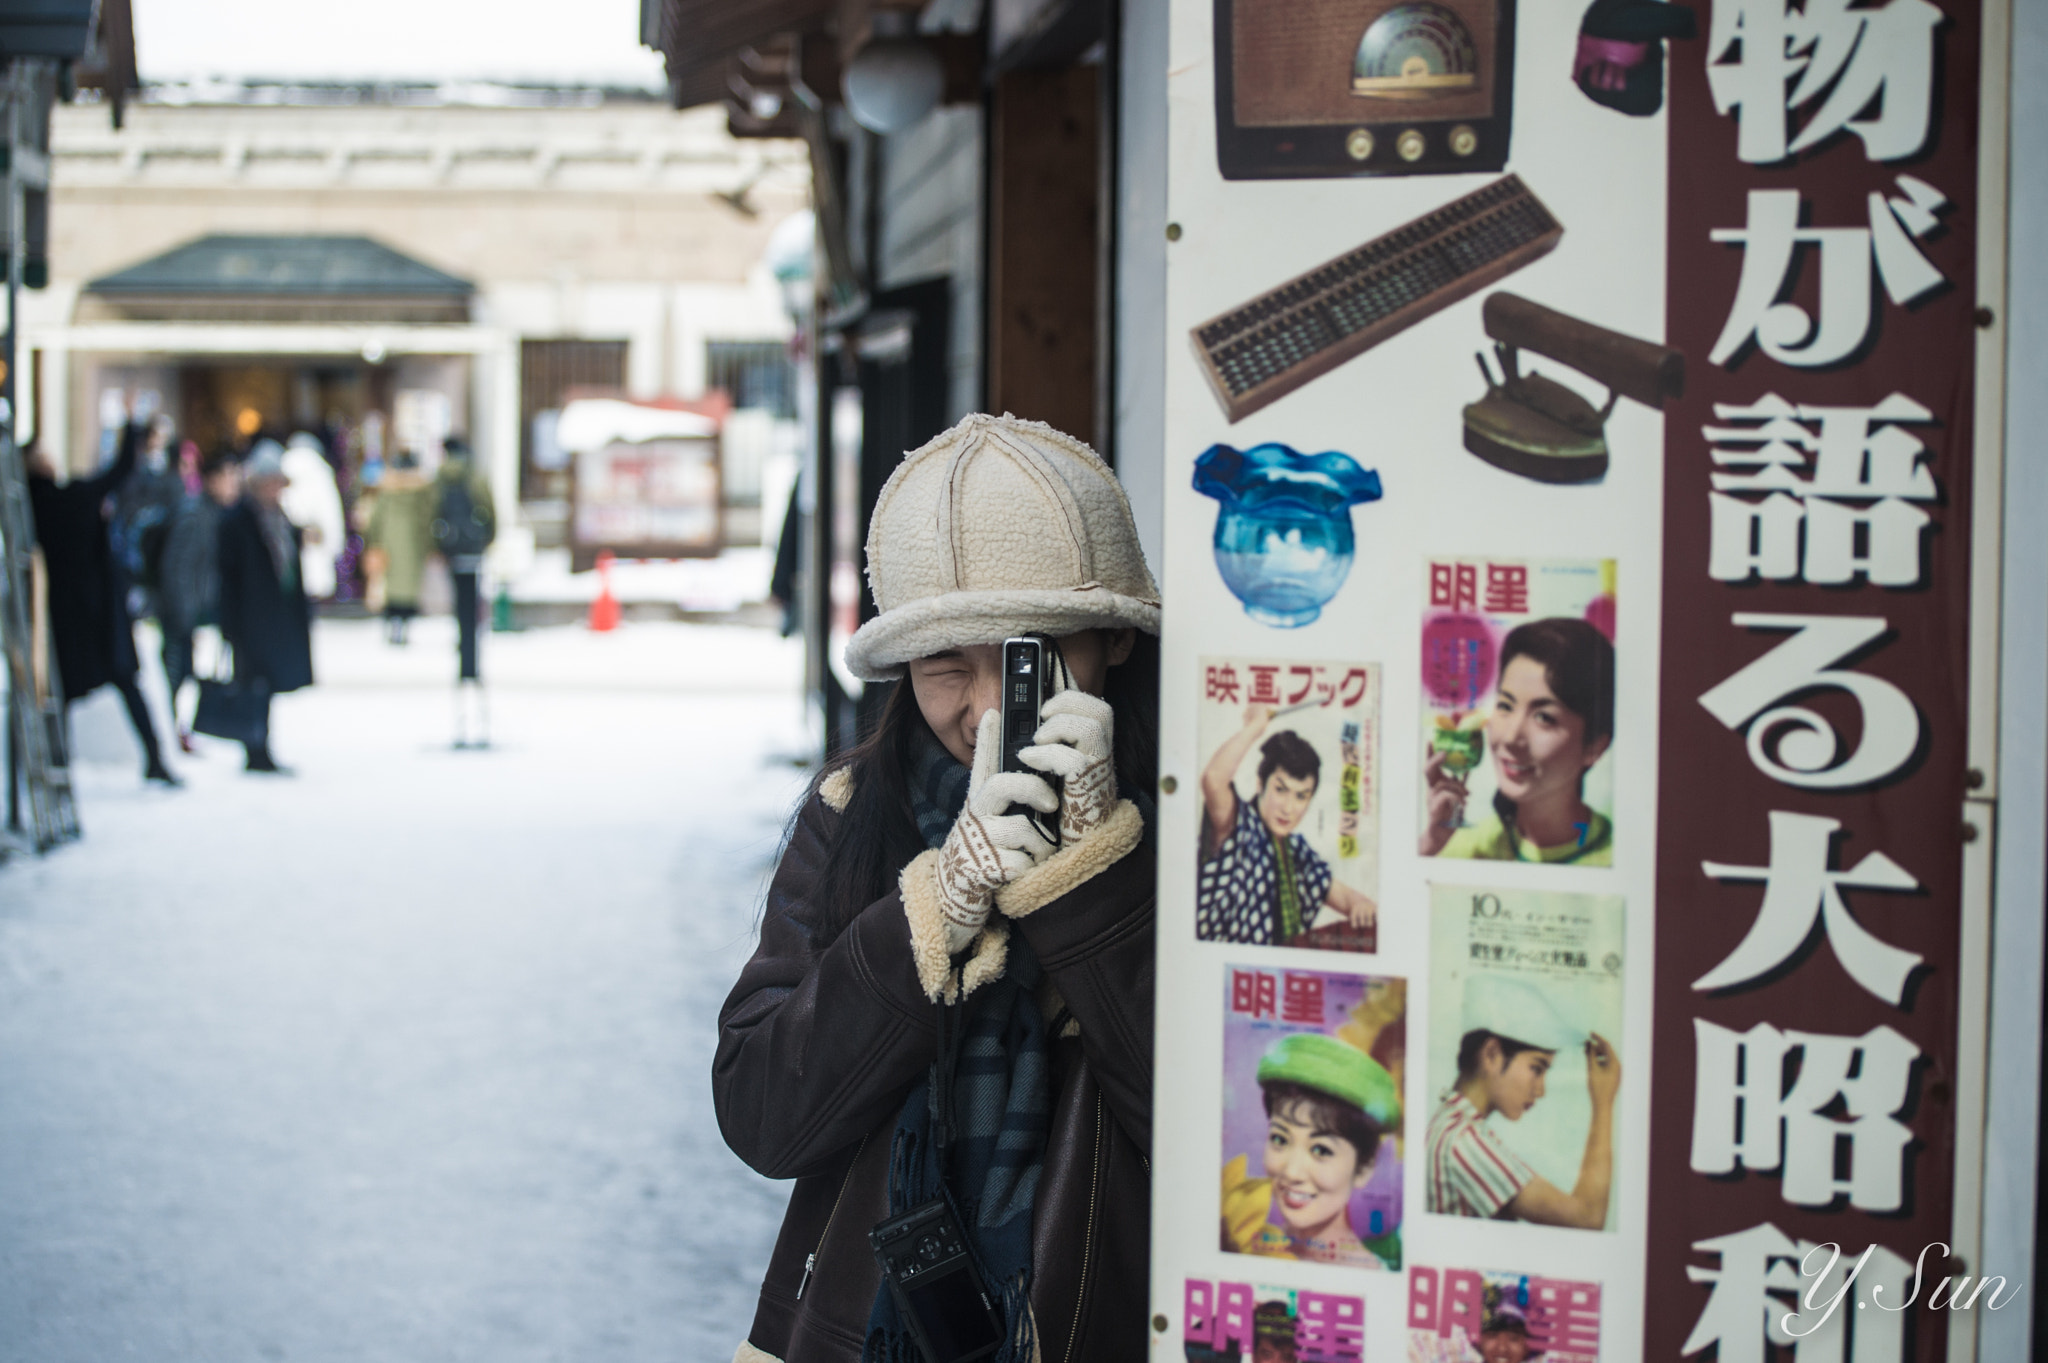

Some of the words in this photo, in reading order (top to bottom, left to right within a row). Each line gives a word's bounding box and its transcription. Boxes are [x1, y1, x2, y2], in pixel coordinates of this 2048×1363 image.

[1206, 664, 1367, 708] 映画ブック
[1573, 823, 1588, 846] 7
